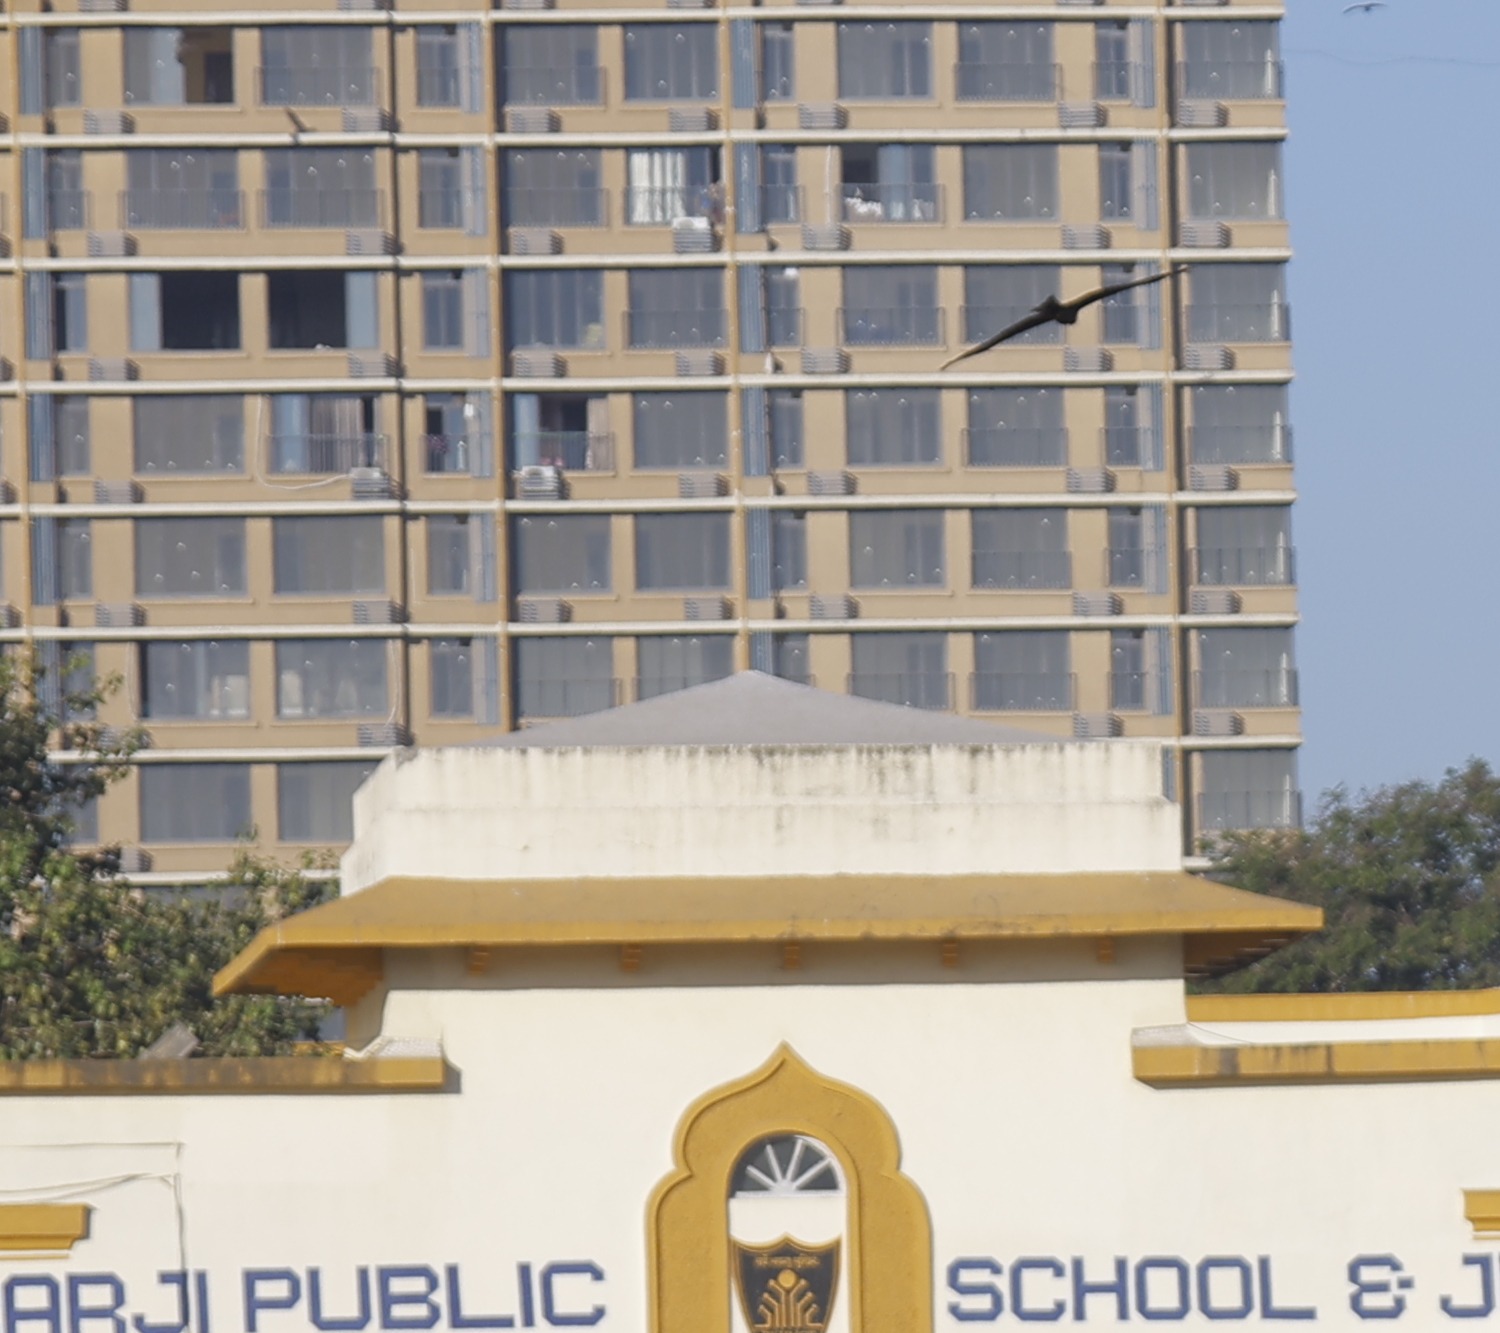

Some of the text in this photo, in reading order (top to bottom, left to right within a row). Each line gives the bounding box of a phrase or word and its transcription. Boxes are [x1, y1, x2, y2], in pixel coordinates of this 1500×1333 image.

[244, 1262, 607, 1333] PUBLIC
[947, 1256, 1316, 1323] SCHOOL
[1348, 1255, 1415, 1320] &
